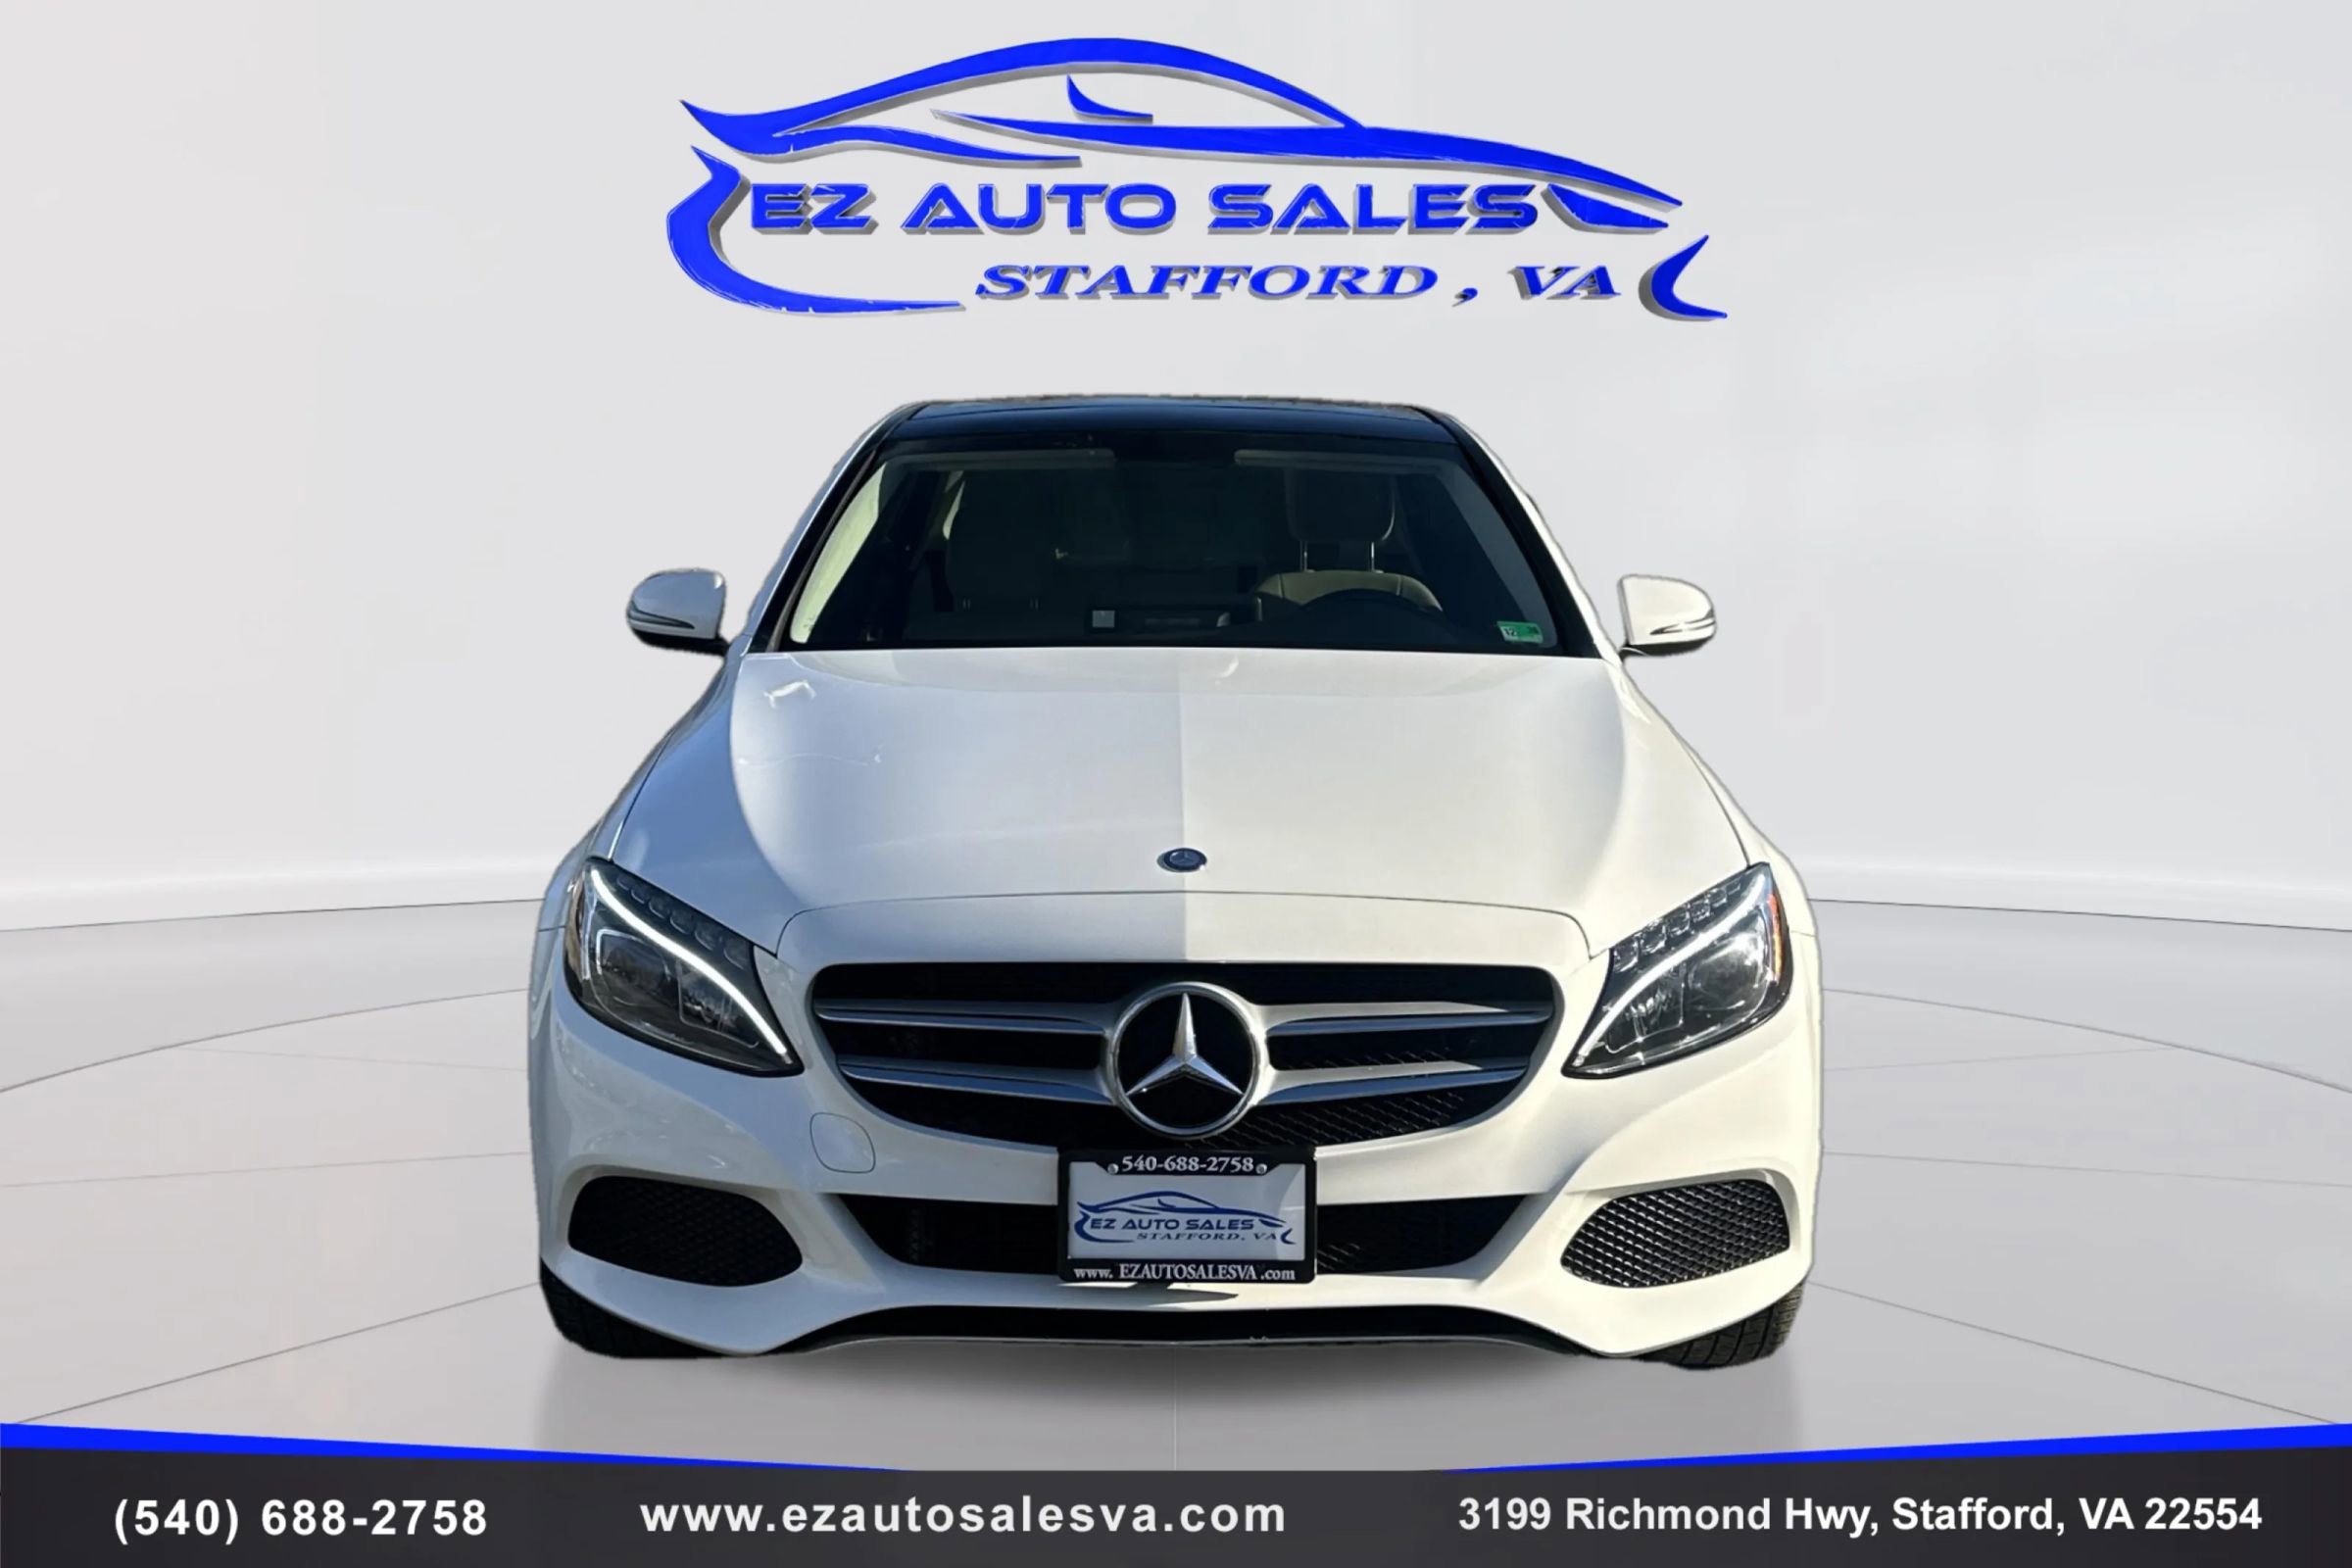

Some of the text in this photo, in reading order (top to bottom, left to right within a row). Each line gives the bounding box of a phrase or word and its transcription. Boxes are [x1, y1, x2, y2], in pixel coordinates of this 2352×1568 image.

[1121, 1155, 1254, 1172] 540-688-2758
[1090, 1218, 1254, 1230] EZ AUTO SALES
[1253, 1232, 1277, 1241] VA
[1073, 1263, 1296, 1281] www. EZAUTOSALESVA .com
